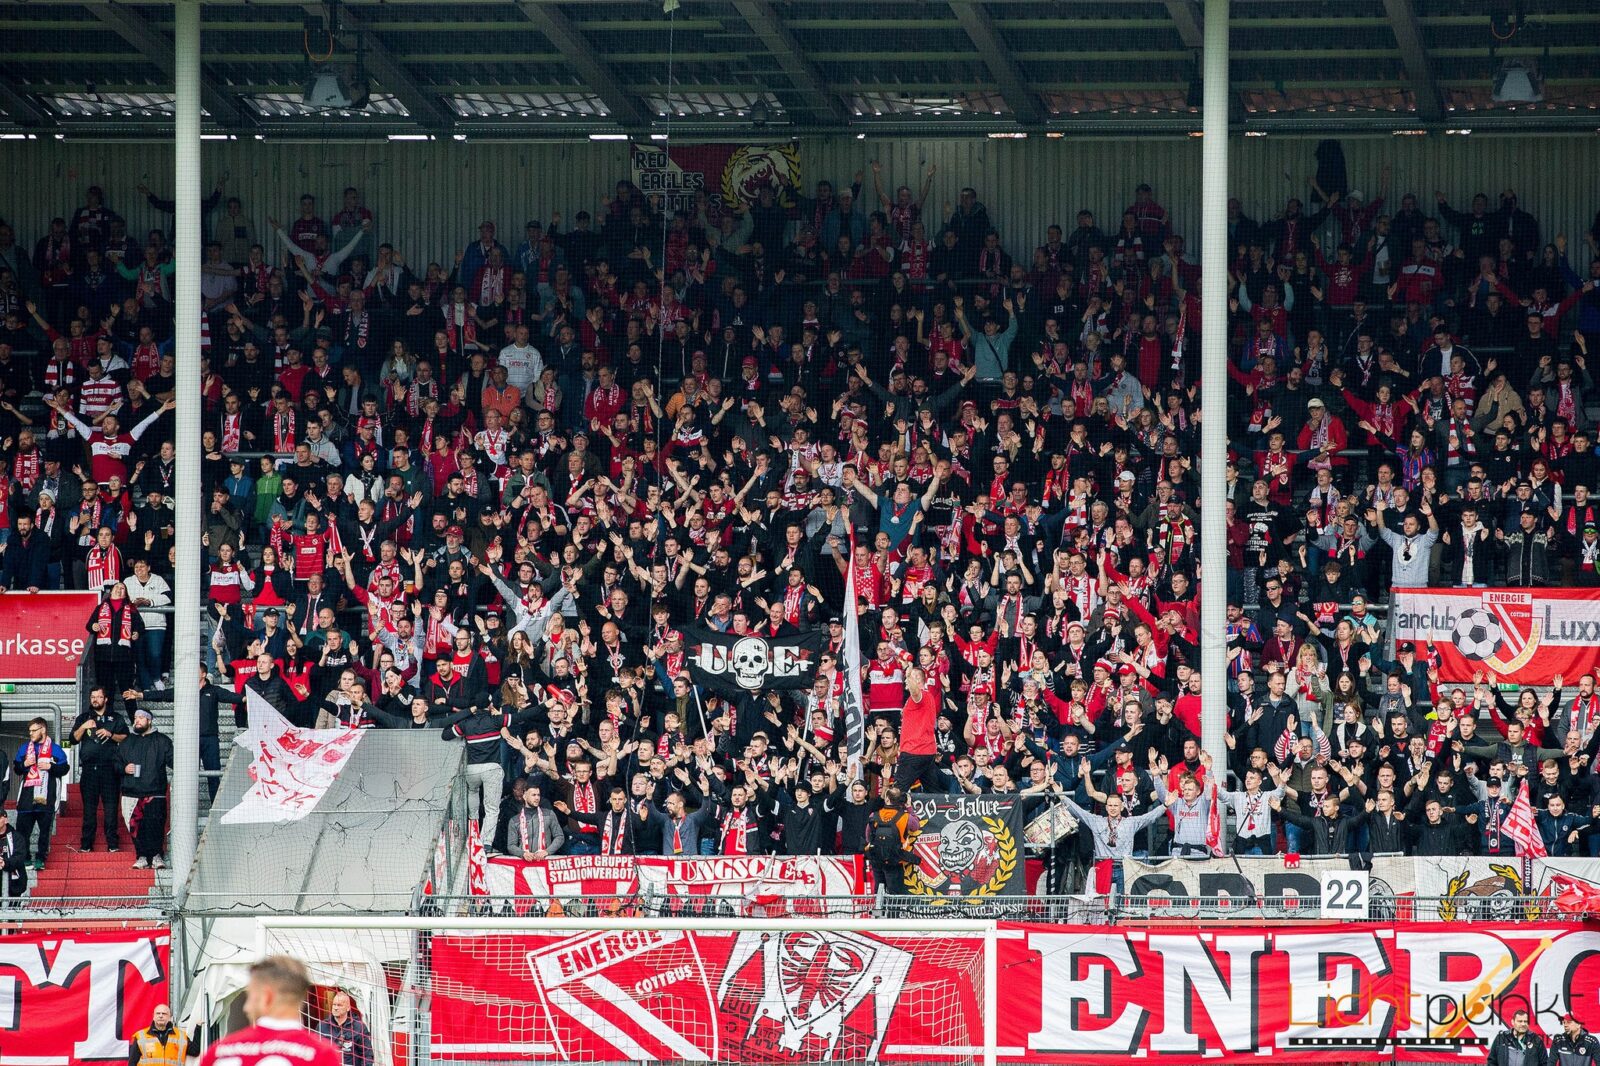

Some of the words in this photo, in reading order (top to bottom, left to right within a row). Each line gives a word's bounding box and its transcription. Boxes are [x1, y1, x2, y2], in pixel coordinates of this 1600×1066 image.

[634, 151, 669, 169] RED
[640, 172, 704, 190] EAGLES
[1489, 593, 1525, 603] ENERGIE
[1395, 605, 1456, 631] anclub
[0, 633, 84, 655] rkasse
[913, 799, 937, 819] 20
[944, 795, 1000, 822] Jahre
[548, 857, 573, 870] EHRE
[574, 856, 593, 869] DER
[594, 855, 633, 868] GRUPPE
[549, 867, 633, 883] STADIONVERBOT
[1326, 880, 1363, 910] 22
[557, 929, 664, 978] ENERGIE
[635, 964, 693, 996] COTTBUS
